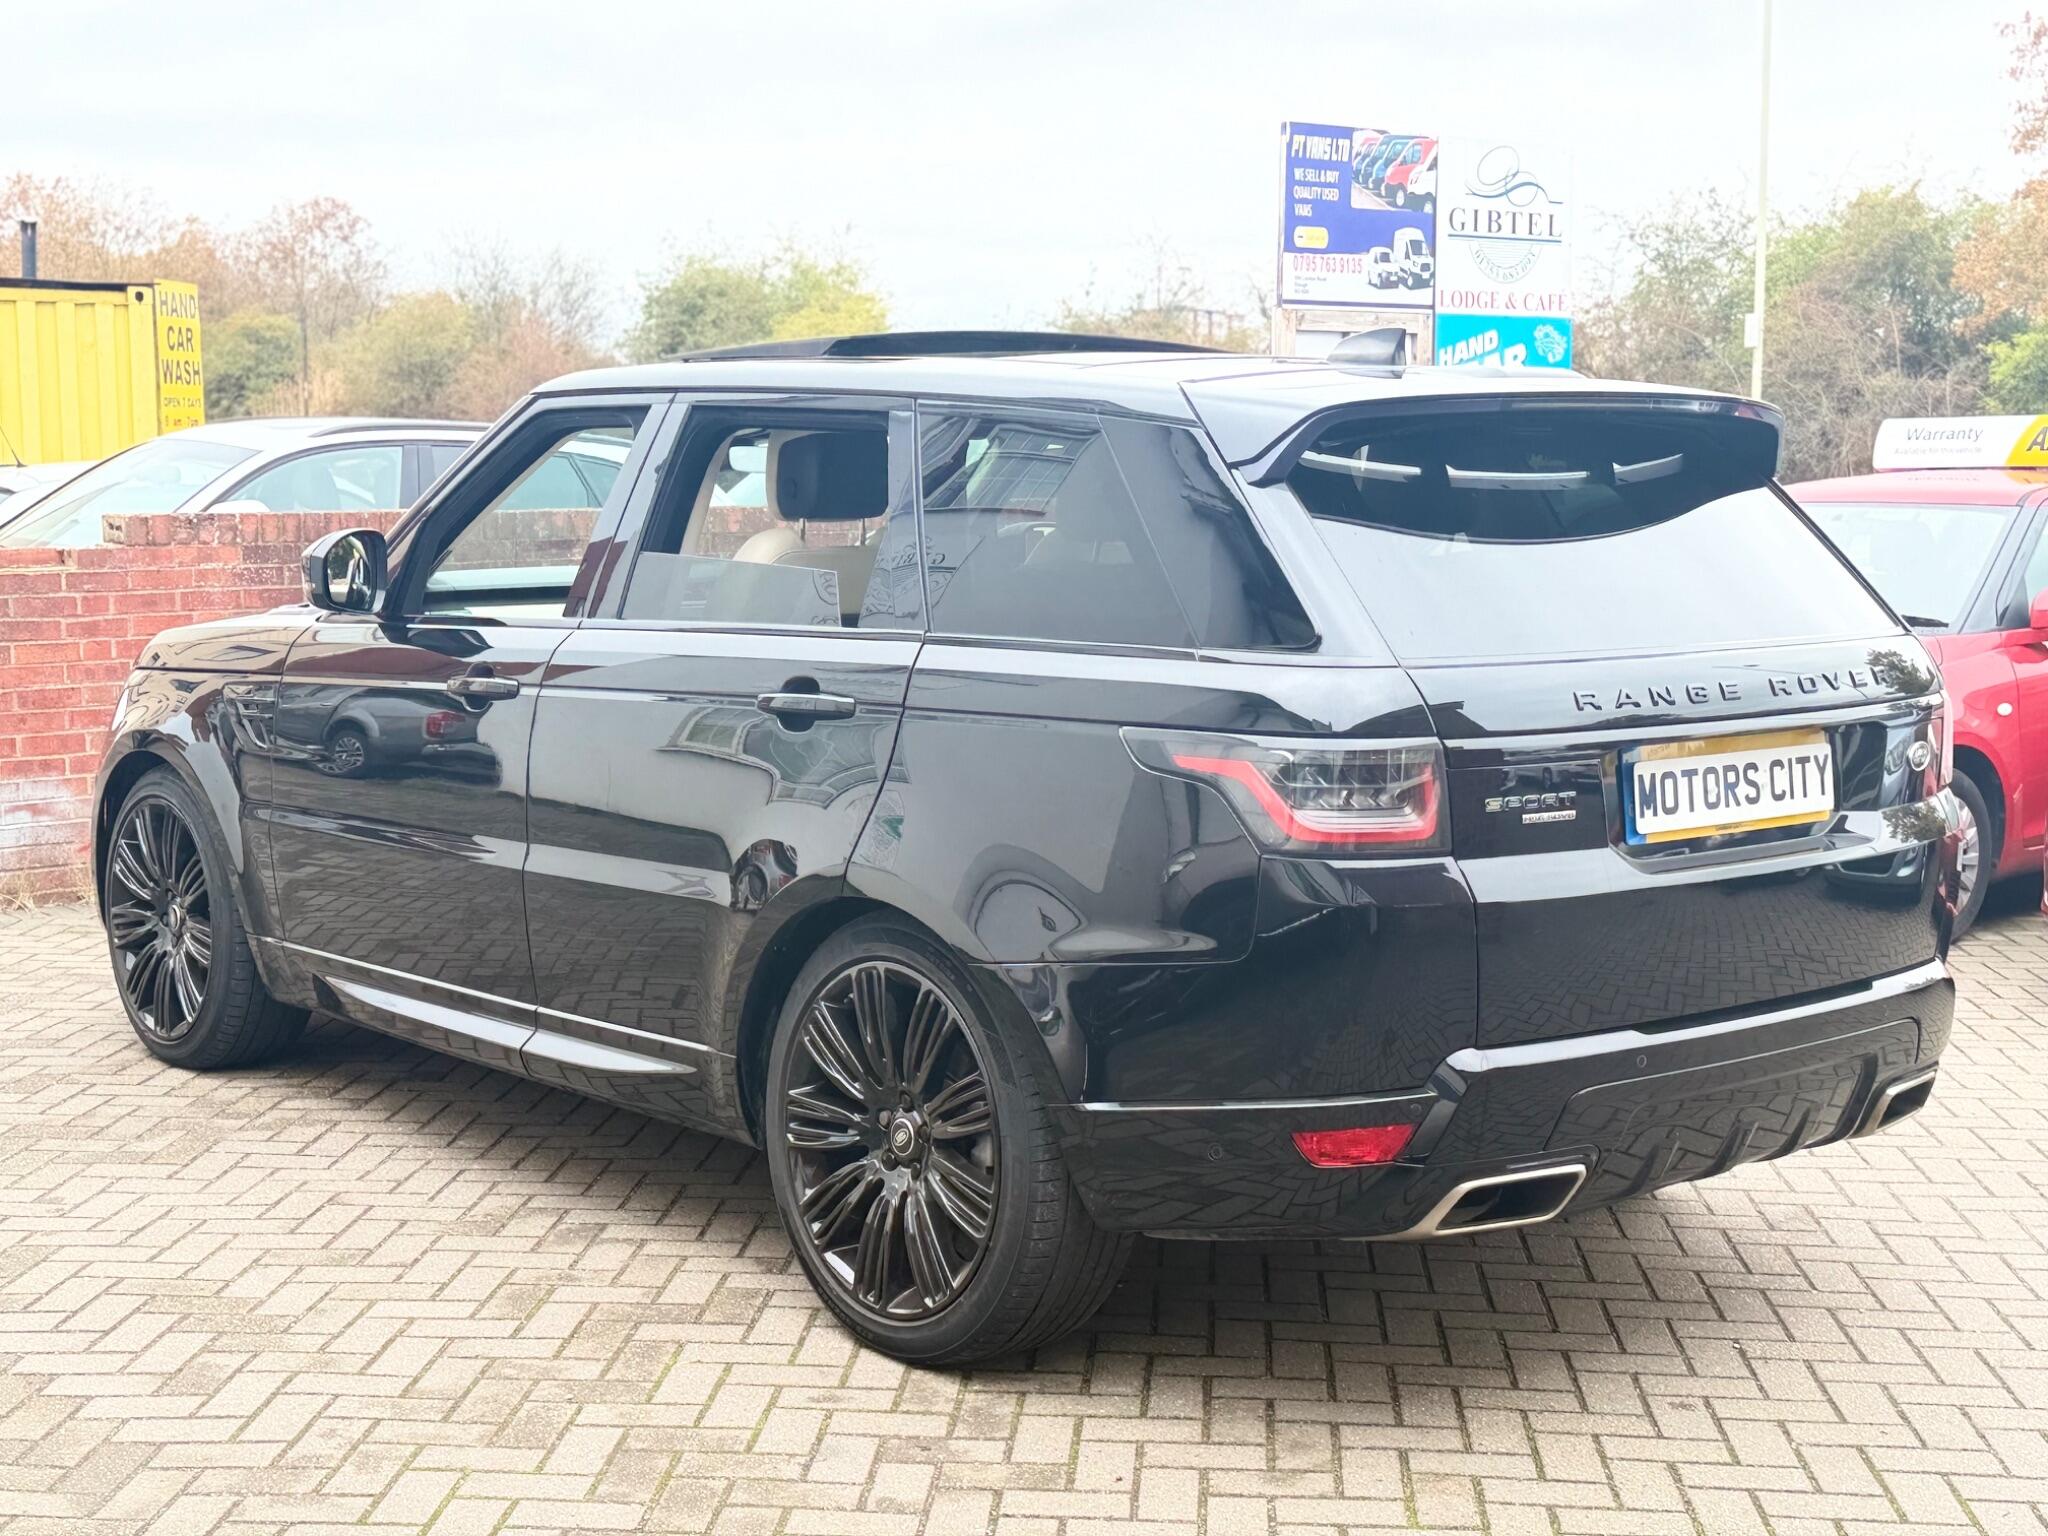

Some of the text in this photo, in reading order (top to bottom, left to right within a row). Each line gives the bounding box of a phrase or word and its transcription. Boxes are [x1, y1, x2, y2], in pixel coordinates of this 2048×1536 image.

[1291, 134, 1350, 162] PT VANS LTD
[1294, 167, 1304, 181] WE
[1305, 168, 1320, 182] SELL
[1326, 170, 1339, 184] BUY
[1293, 185, 1339, 201] QUALITY USED
[1294, 203, 1313, 217] VANS
[1449, 206, 1562, 237] GIBTEL
[1293, 255, 1317, 272] 0795
[1320, 256, 1337, 273] 763
[159, 289, 197, 319] HAND
[1440, 289, 1500, 310] LODGE
[1505, 291, 1517, 310] &
[166, 325, 194, 352] CAR
[1438, 328, 1500, 367] HAND
[161, 358, 202, 386] WASH
[1906, 427, 1984, 442] Warranty
[1573, 666, 1892, 711] RANGE ROVER
[1638, 753, 1830, 819] MOTORS CITY
[1484, 790, 1577, 813] SPORT
